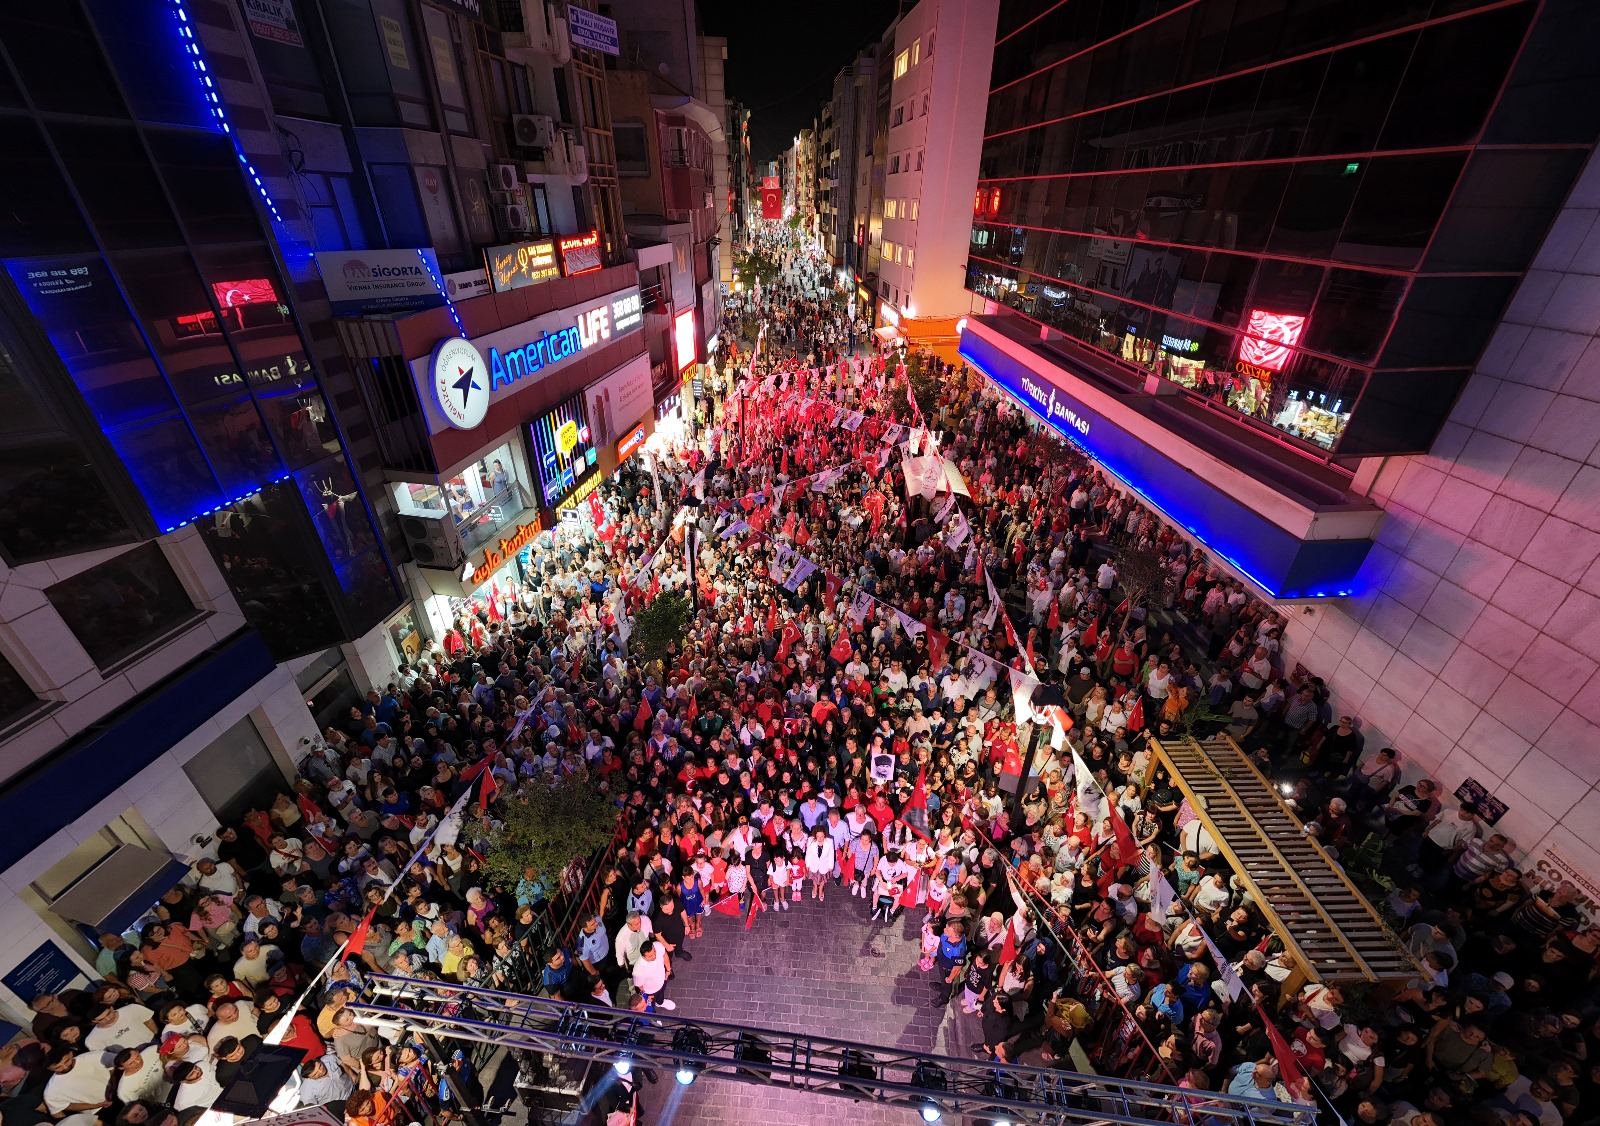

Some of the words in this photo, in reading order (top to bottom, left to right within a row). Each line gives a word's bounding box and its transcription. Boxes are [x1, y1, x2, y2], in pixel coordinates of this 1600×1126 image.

[371, 264, 423, 277] SİGORTA
[1021, 377, 1049, 406] TÜRKİYE
[1054, 402, 1090, 436] BANKASI
